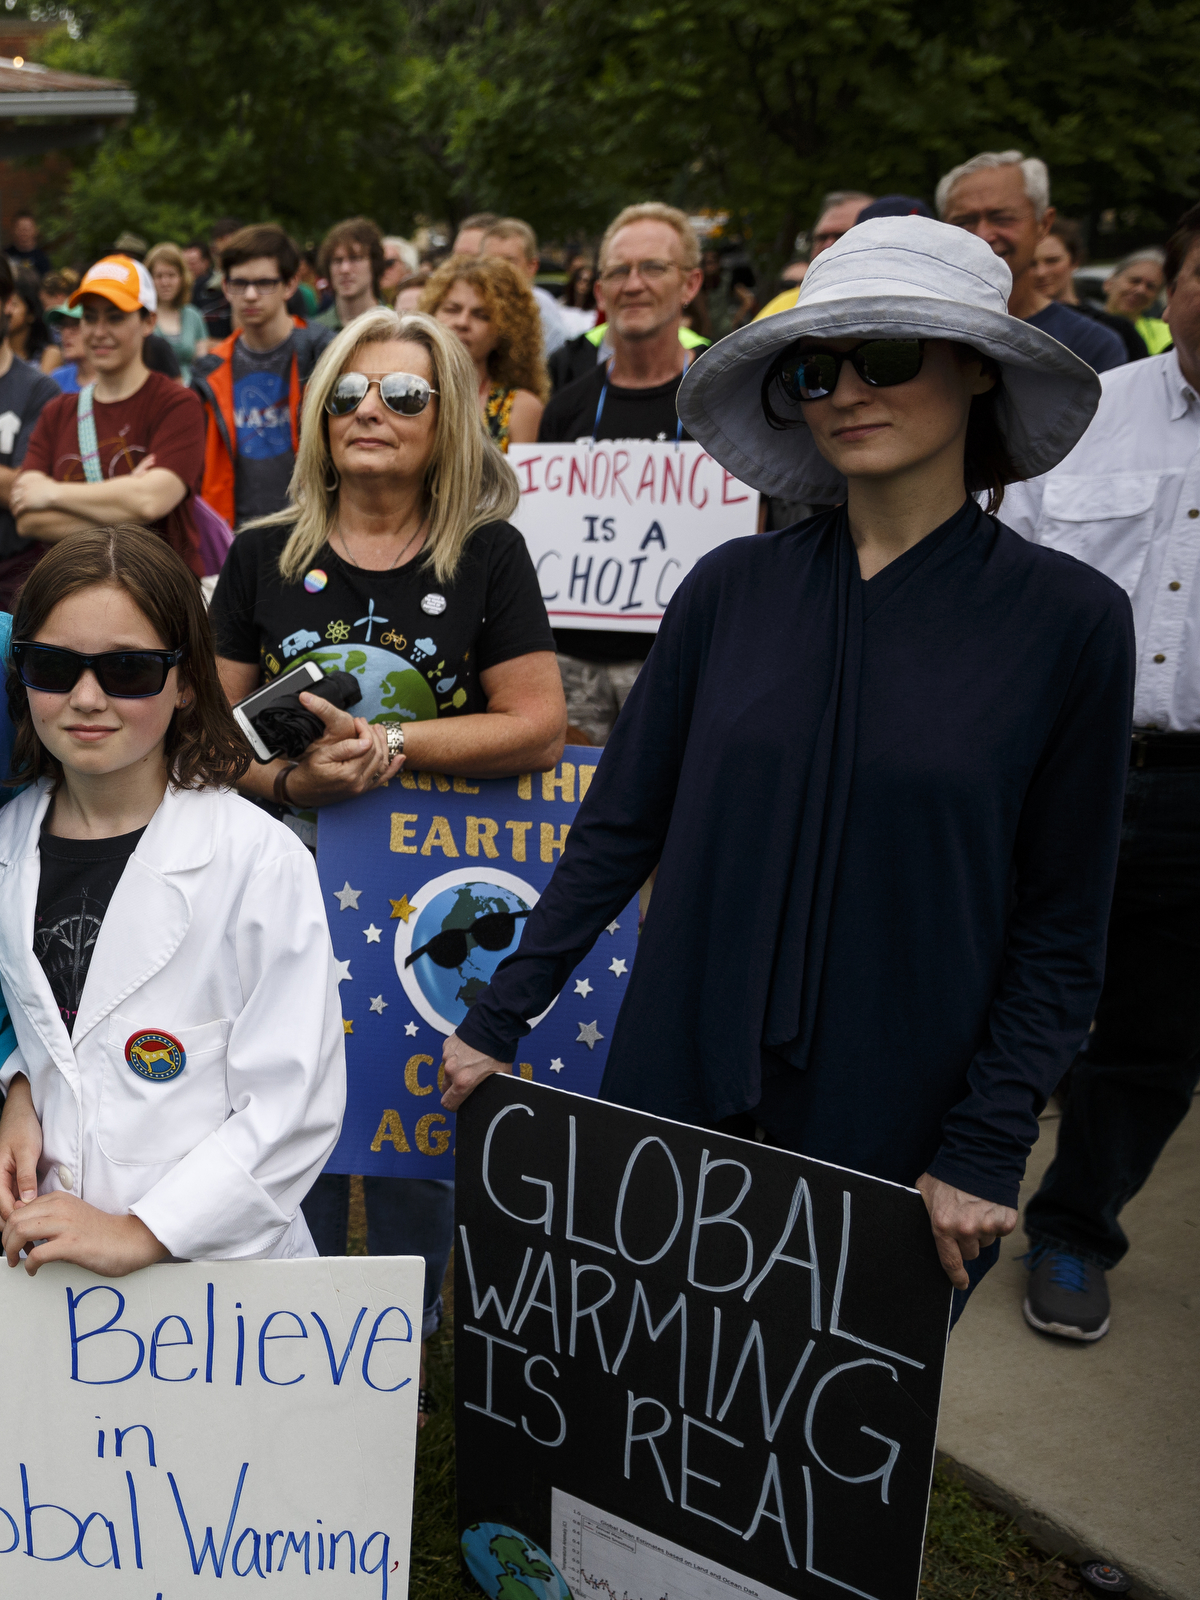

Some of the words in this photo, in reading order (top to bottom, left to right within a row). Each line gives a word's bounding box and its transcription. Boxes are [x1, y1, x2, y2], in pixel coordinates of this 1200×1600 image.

[516, 450, 749, 510] IGNORANCE
[583, 515, 617, 542] IS
[639, 520, 667, 550] A
[536, 550, 682, 611] CHOIC
[390, 811, 567, 863] EARTH
[482, 1103, 925, 1369] GLOBAL
[66, 1282, 413, 1392] Believe
[459, 1225, 902, 1504] WARMING
[94, 1415, 157, 1467] in
[463, 1324, 567, 1447] IS
[624, 1390, 882, 1600] REAL
[600, 1519, 619, 1531] Global
[619, 1527, 635, 1539] Mean
[636, 1536, 665, 1554] Estimates
[665, 1550, 684, 1563] based
[684, 1559, 693, 1567] on
[693, 1563, 709, 1575] Land
[709, 1570, 722, 1580] and
[722, 1576, 743, 1590] Ocean
[743, 1586, 760, 1598] Data
